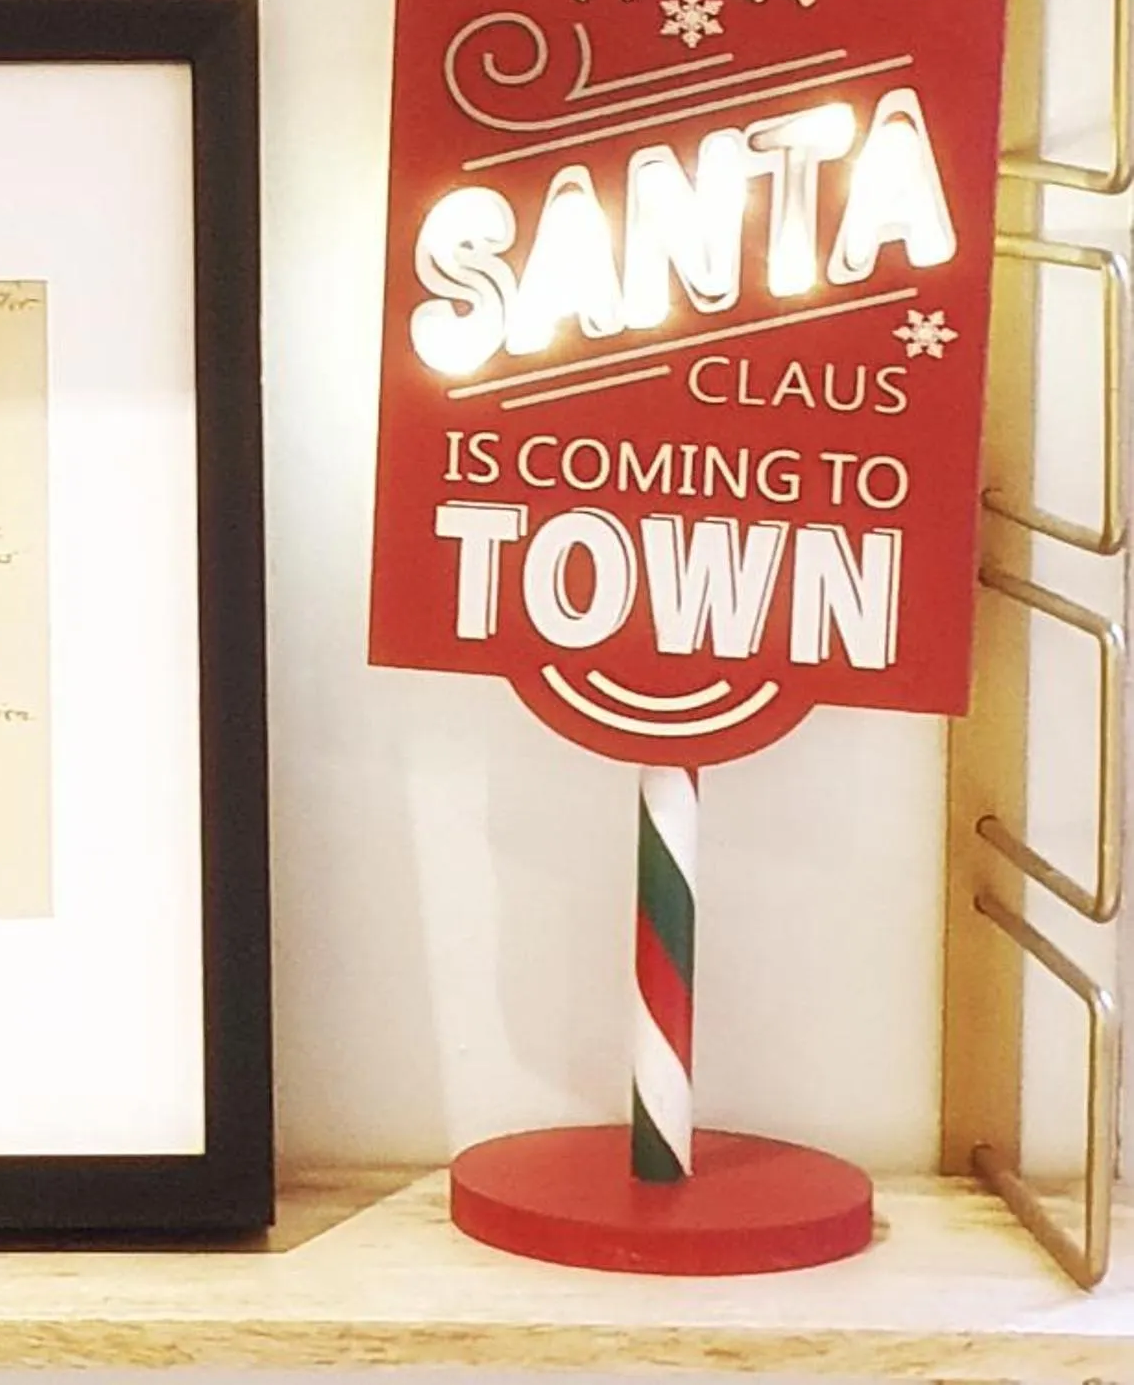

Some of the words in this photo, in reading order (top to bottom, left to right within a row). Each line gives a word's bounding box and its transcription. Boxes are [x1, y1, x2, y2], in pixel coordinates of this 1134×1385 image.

[410, 88, 957, 376] SANTA
[687, 357, 908, 414] CLAUS
[444, 431, 500, 484] IS
[517, 435, 801, 503] COMING
[820, 452, 909, 508] TO
[435, 501, 903, 670] TOWN
